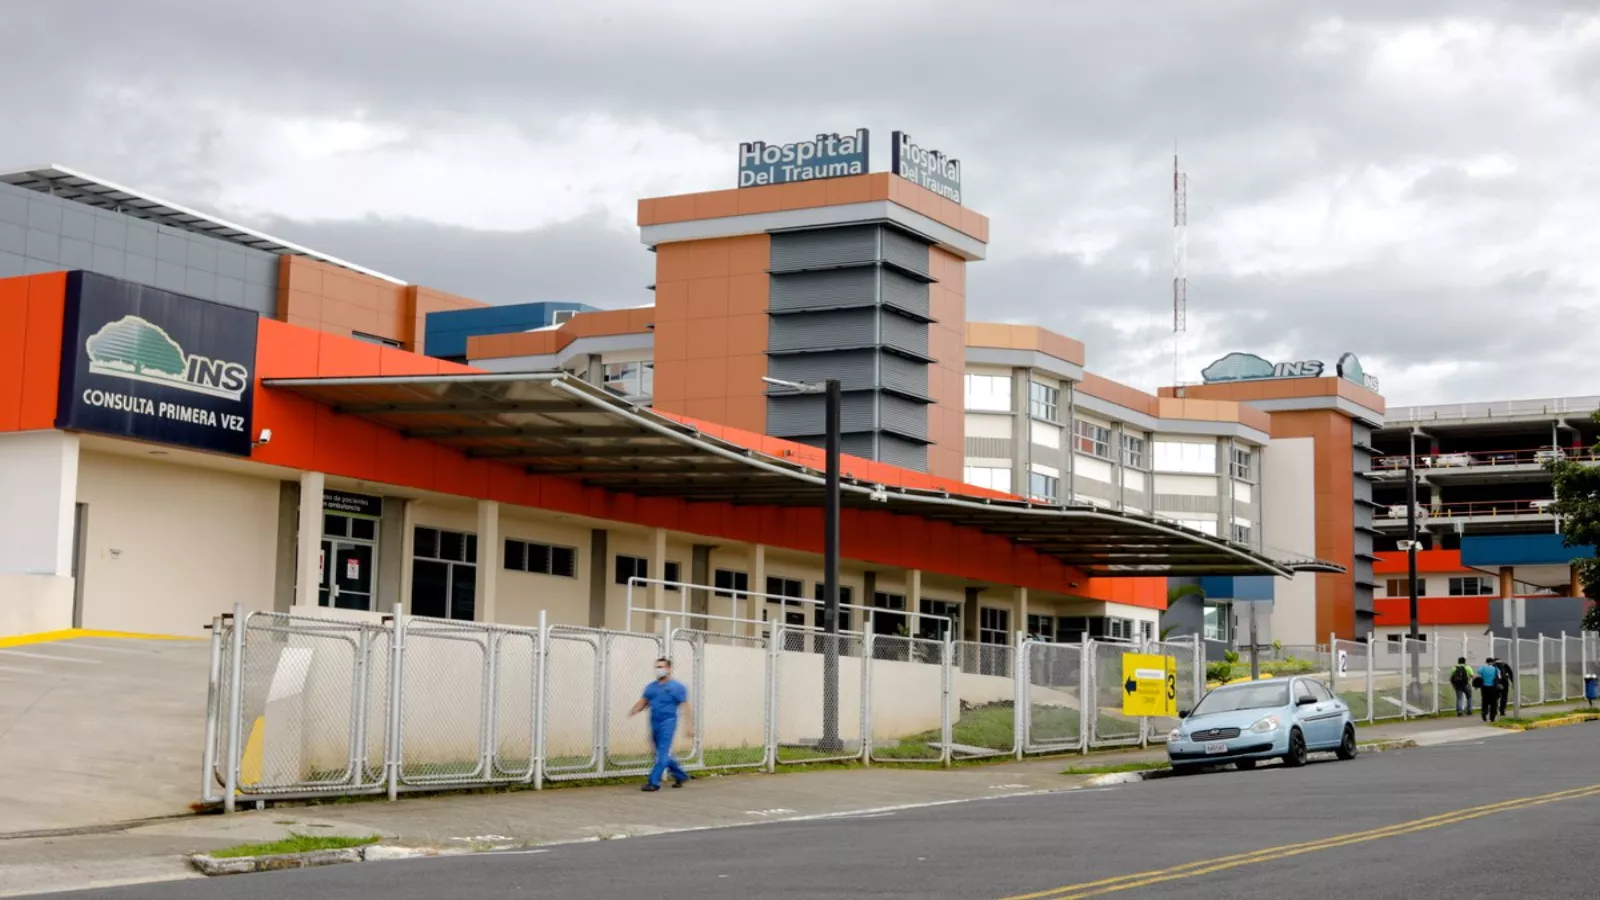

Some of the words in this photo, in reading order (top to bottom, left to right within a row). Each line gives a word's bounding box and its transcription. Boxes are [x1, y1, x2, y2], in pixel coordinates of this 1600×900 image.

[740, 130, 864, 166] Hospital
[900, 134, 960, 184] Hospital
[740, 167, 774, 187] Del
[781, 160, 862, 182] Trauma
[900, 161, 919, 184] Del
[922, 171, 960, 203] Trauma
[186, 354, 249, 391] INS
[1273, 360, 1324, 378] INS
[83, 389, 155, 416] CONSULTA
[159, 402, 217, 427] PRIMERA
[220, 412, 245, 432] VEZ
[328, 502, 361, 512] ambulancia
[1167, 674, 1175, 700] 3
